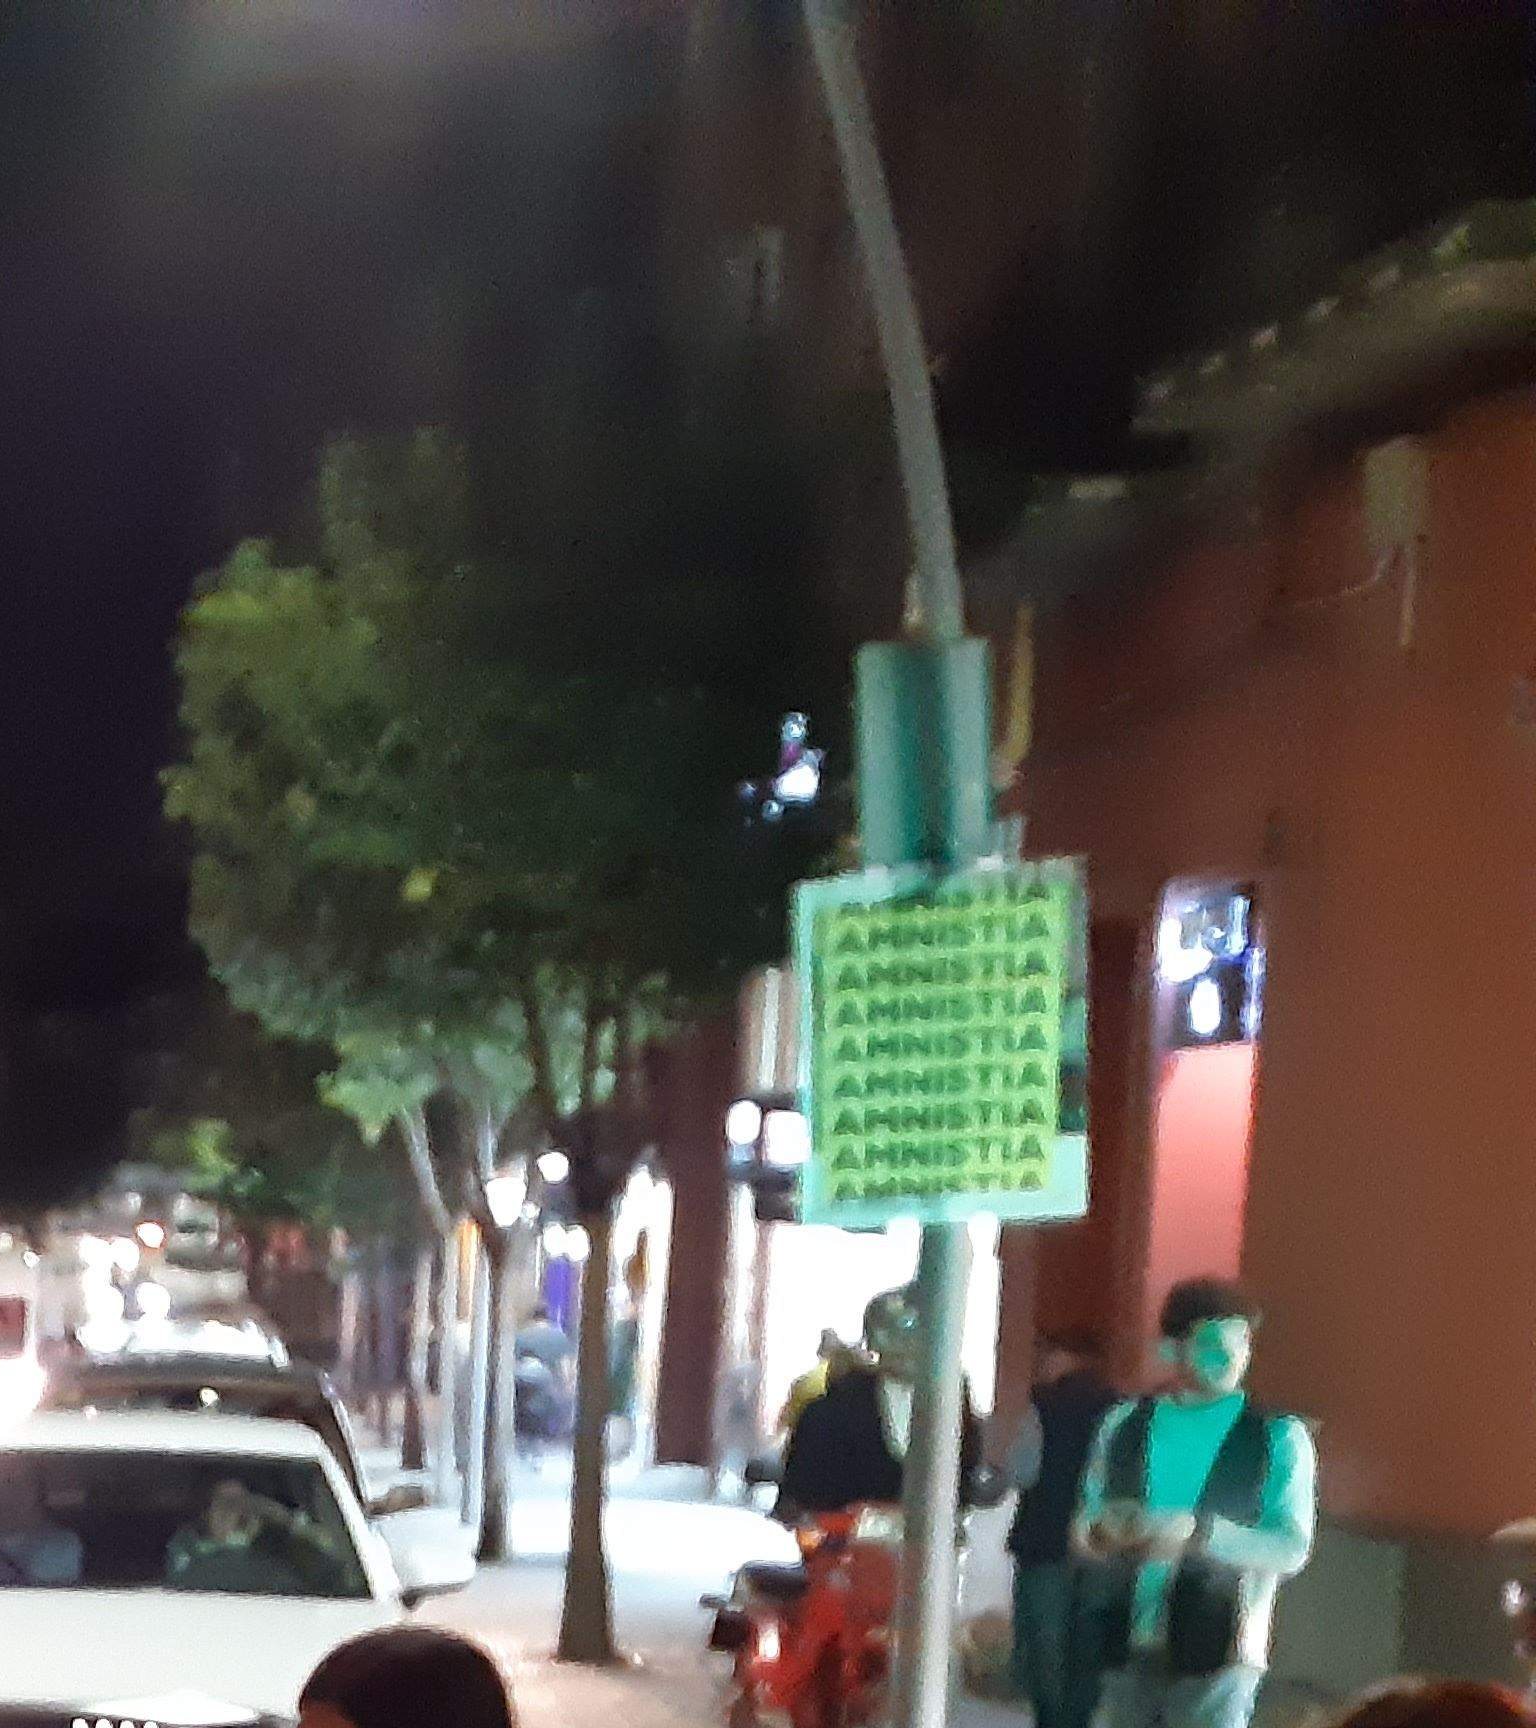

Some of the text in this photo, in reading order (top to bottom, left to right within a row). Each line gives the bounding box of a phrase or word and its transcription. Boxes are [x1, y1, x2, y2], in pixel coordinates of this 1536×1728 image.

[836, 912, 1049, 951] AMNISTIA
[836, 950, 1048, 990] AMNISTIA
[836, 985, 1047, 1026] AMNISTIA
[833, 1023, 1047, 1062] AMNISTIA
[833, 1061, 1047, 1098] AMNISTIA
[832, 1098, 1046, 1135] AMNISTIA
[831, 1134, 1045, 1169] AMNISTIA
